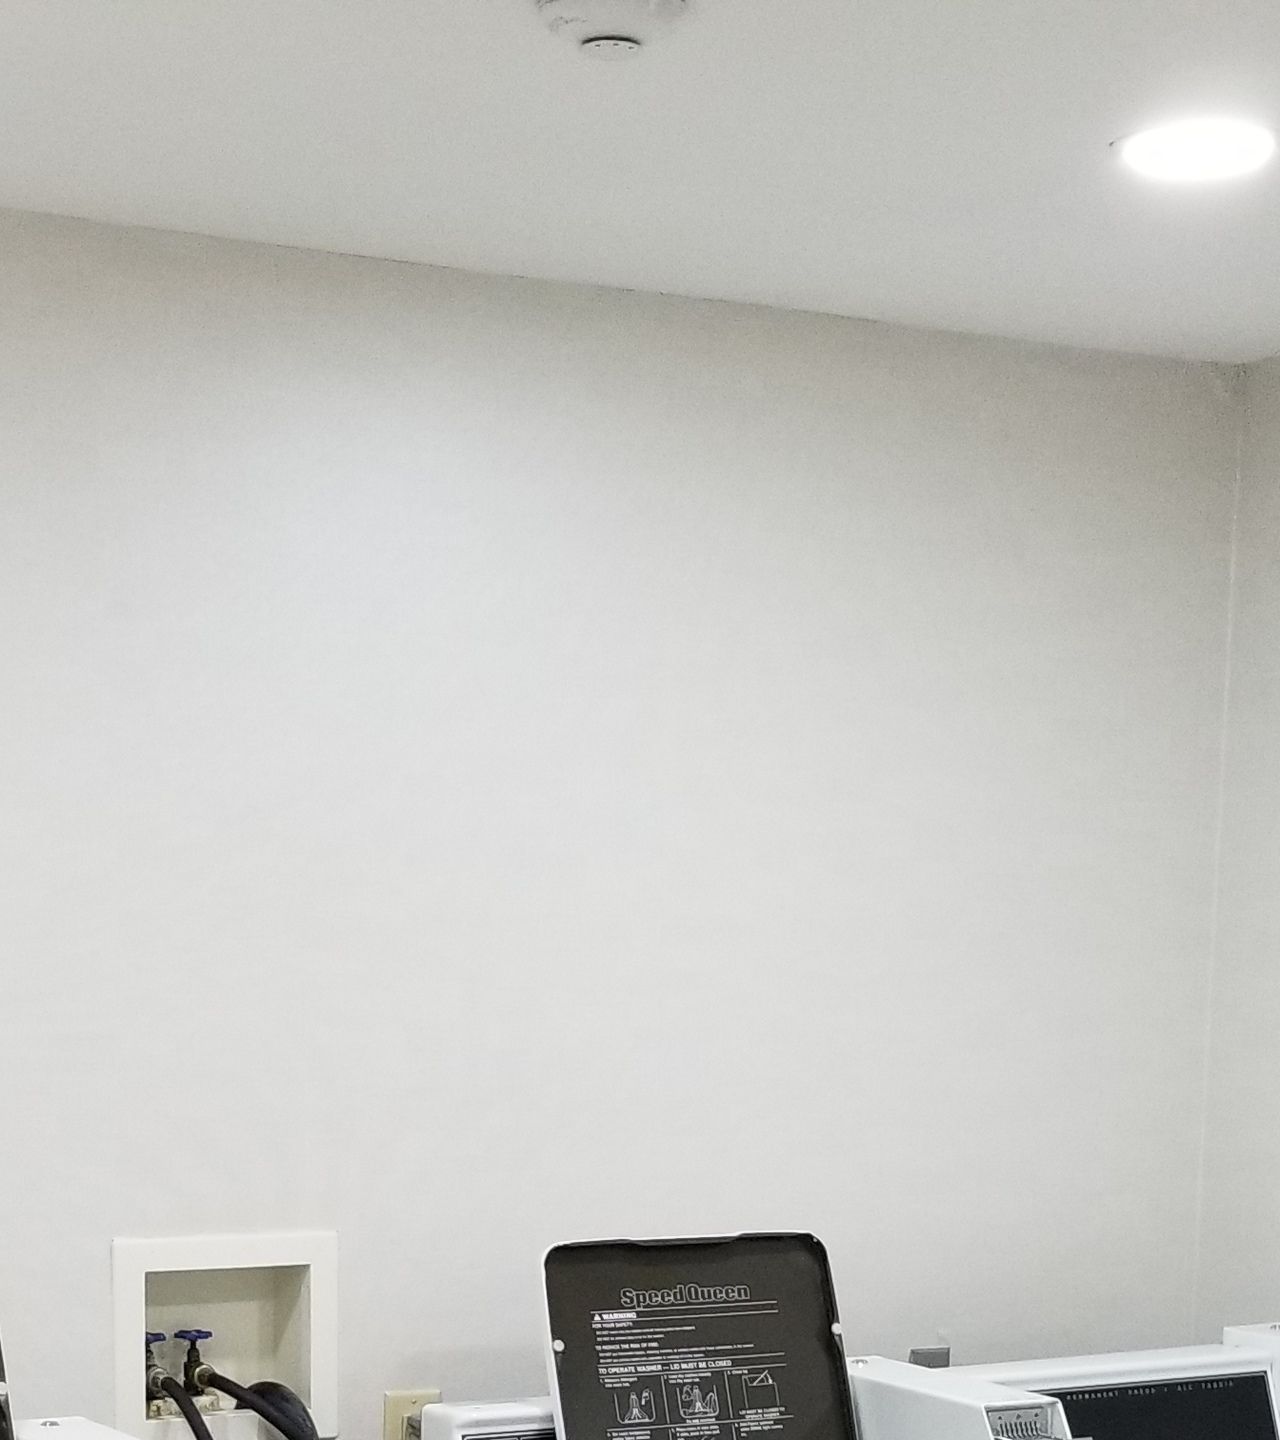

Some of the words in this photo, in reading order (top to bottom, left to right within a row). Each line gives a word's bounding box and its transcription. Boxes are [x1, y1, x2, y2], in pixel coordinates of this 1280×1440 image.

[621, 1285, 686, 1310] Speed
[686, 1283, 751, 1302] Queen
[599, 1367, 607, 1375] TO
[608, 1365, 636, 1374] OPERATE
[637, 1363, 662, 1372] WASHER
[708, 1359, 732, 1368] CLOSED
